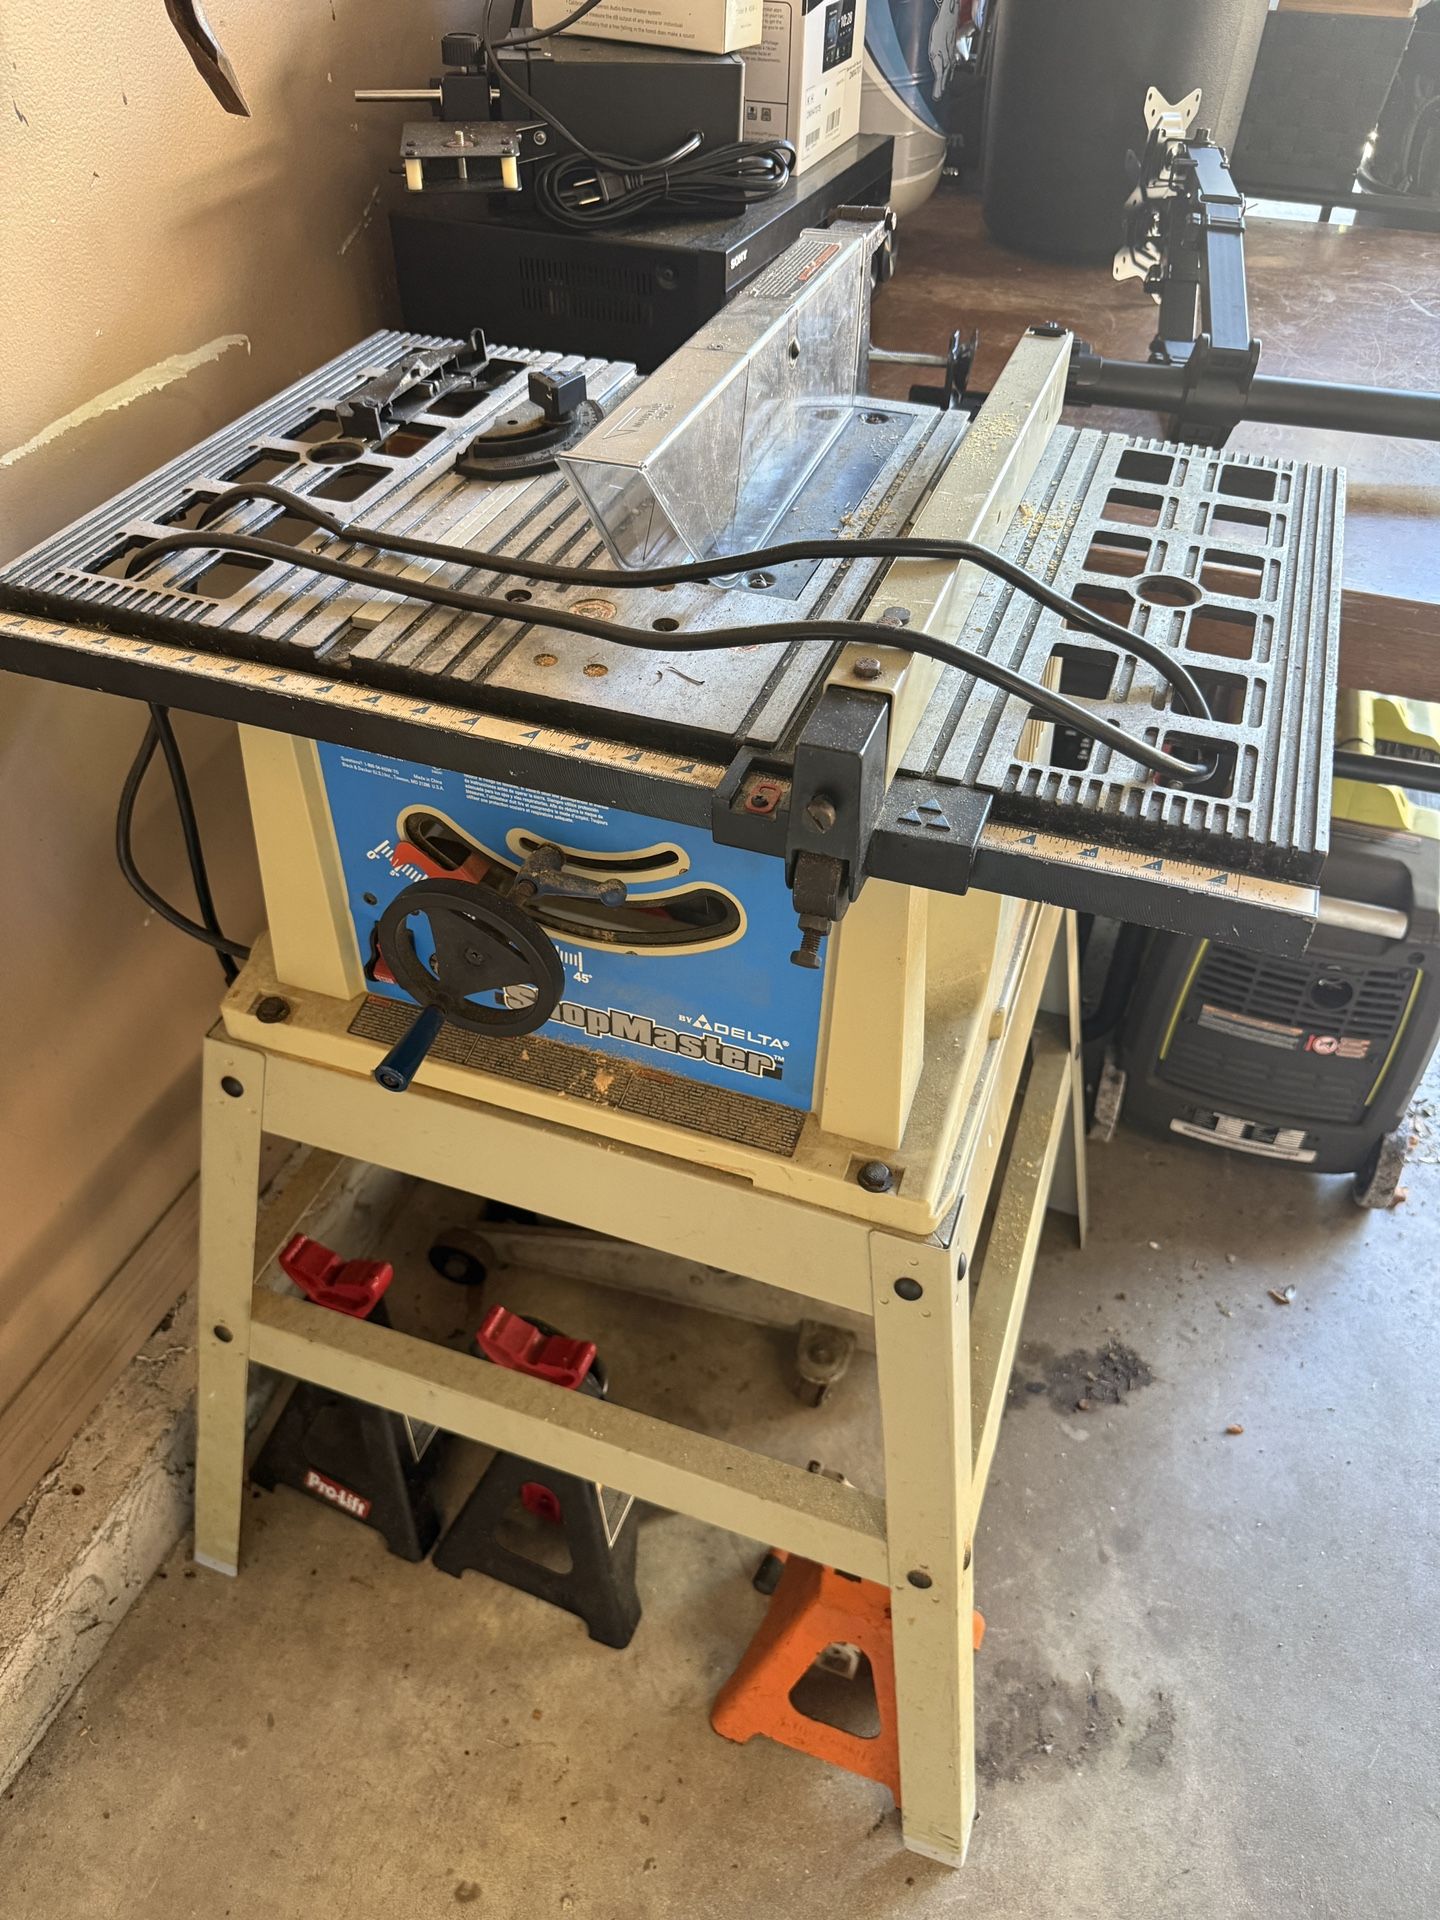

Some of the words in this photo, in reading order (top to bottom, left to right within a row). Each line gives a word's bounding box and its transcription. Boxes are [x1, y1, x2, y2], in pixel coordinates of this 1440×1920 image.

[731, 249, 748, 270] SONY
[573, 972, 593, 983] 45°
[678, 1013, 692, 1024] BY
